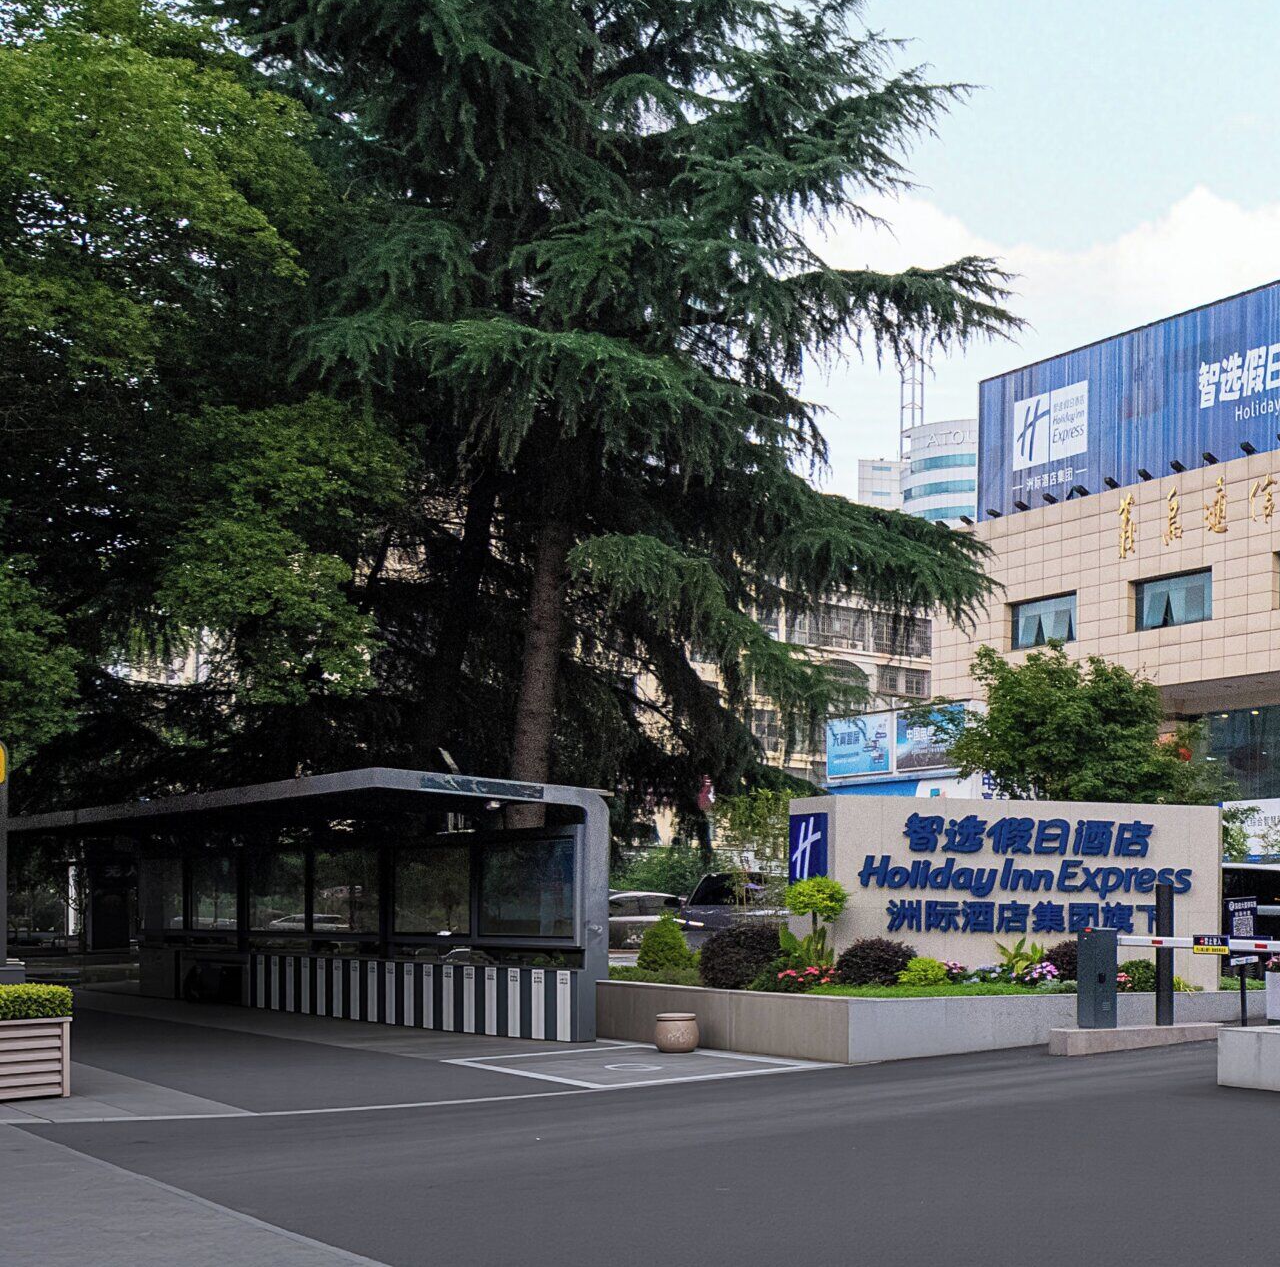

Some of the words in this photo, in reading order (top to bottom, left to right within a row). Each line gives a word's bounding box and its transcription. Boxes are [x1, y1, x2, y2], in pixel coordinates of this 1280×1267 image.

[1235, 397, 1280, 422] Holiday
[1052, 424, 1085, 445] Express
[1026, 467, 1073, 491] 洲际酒店集团
[903, 812, 1154, 858] 智选假日酒店
[858, 854, 999, 898] Holiday
[1000, 857, 1056, 892] Inn
[1056, 859, 1192, 899] Express
[886, 899, 1157, 934] 洲际酒店集团旗下
